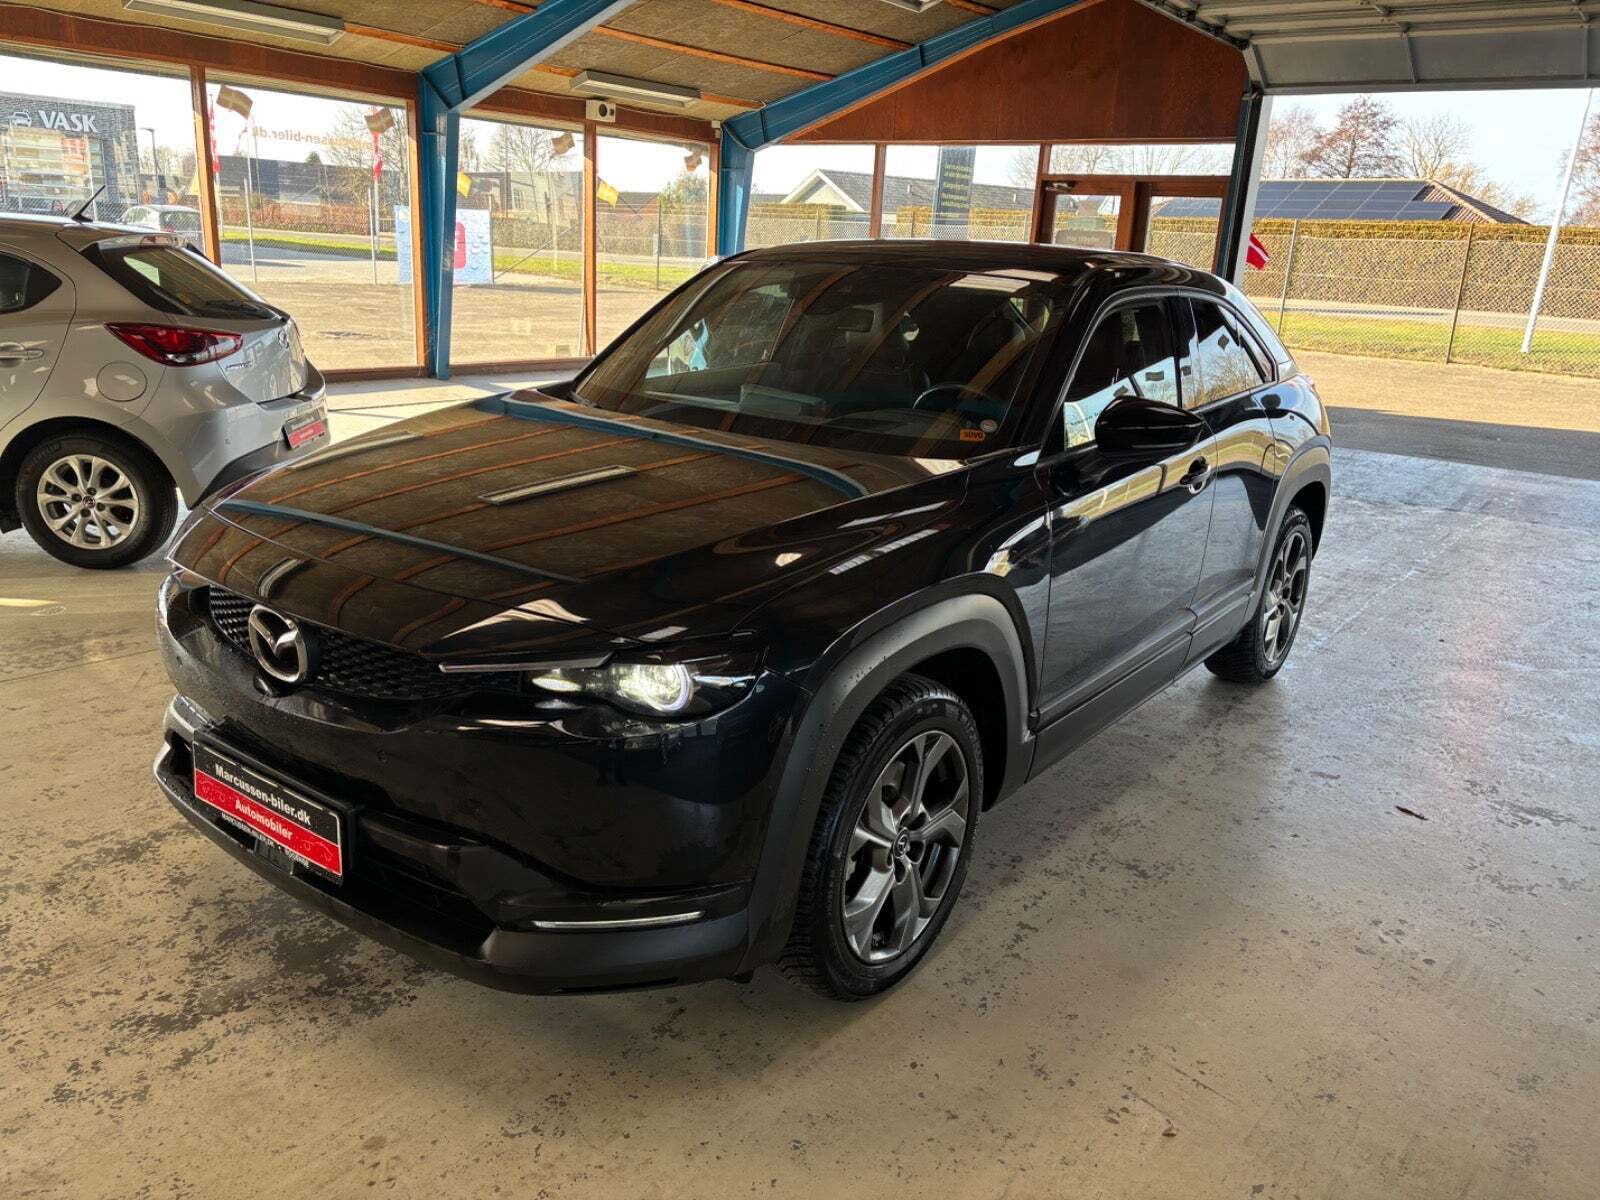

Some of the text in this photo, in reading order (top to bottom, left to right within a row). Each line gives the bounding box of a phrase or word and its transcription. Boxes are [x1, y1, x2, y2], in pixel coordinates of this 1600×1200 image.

[38, 110, 98, 133] VASK
[215, 763, 312, 826] Marcussen-biler.dk
[235, 799, 293, 840] Automobiler
